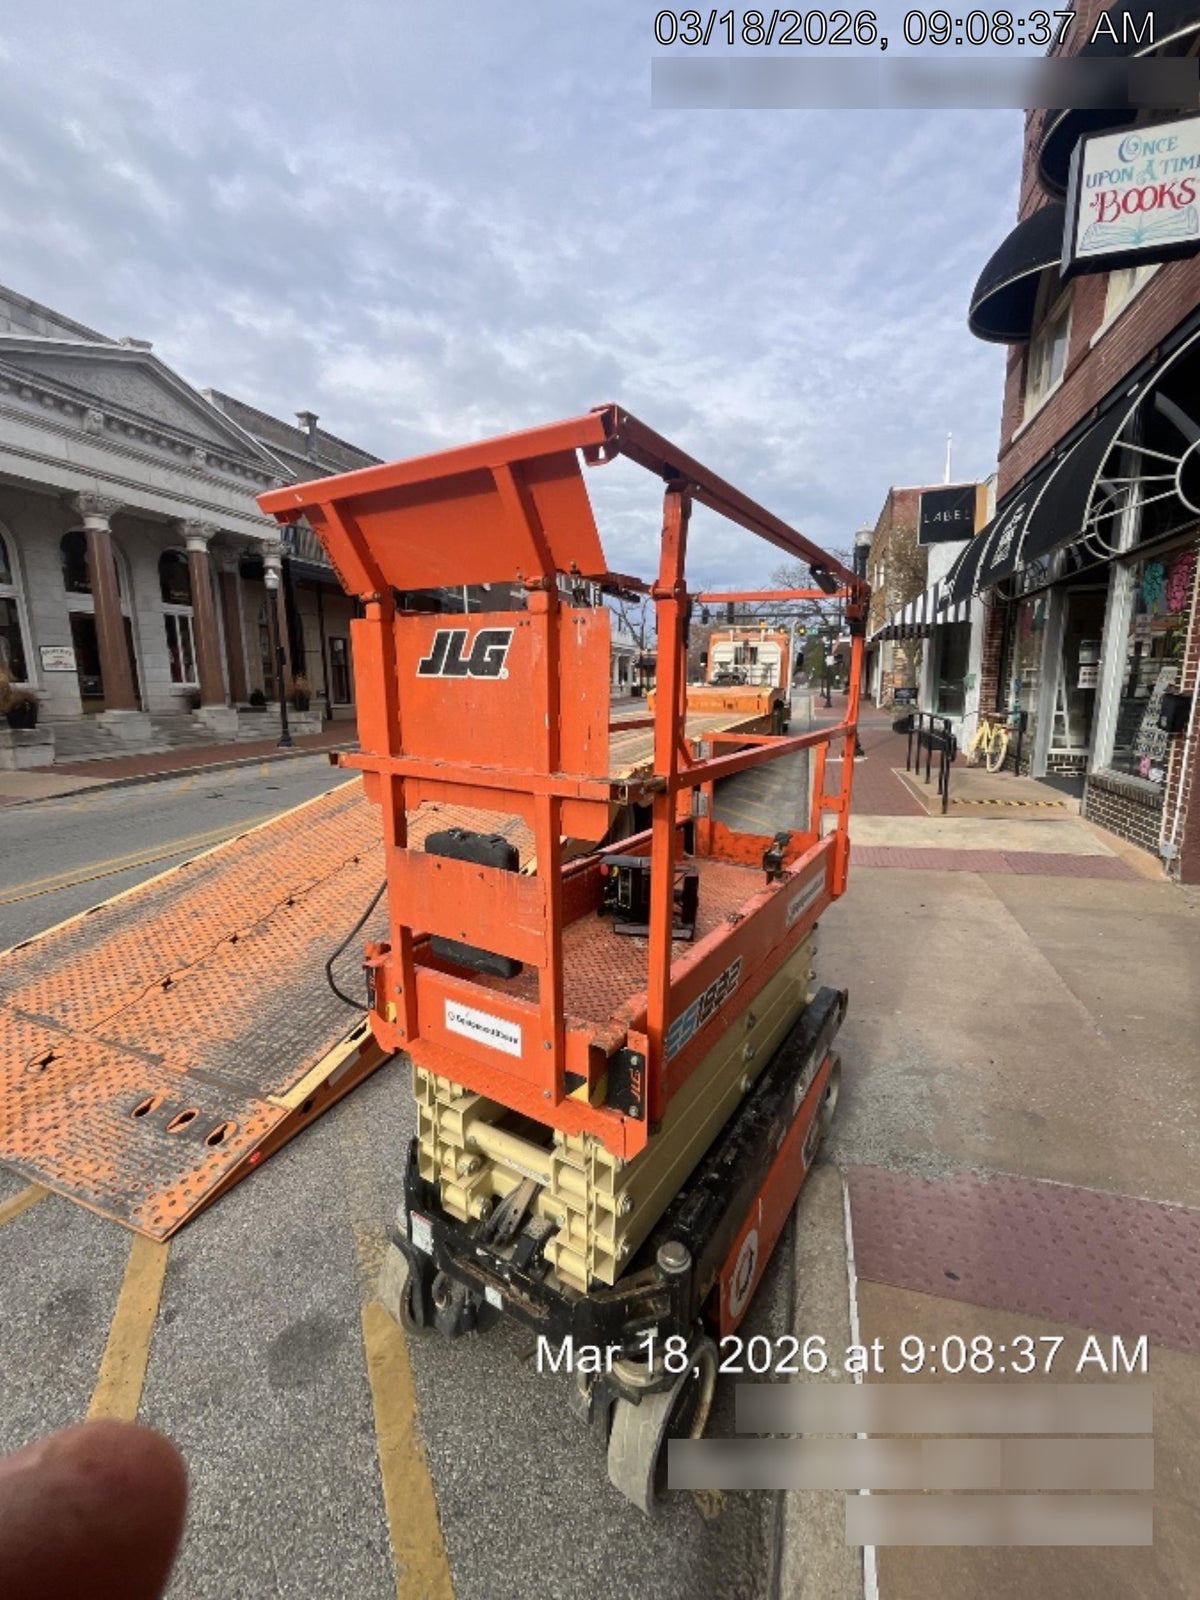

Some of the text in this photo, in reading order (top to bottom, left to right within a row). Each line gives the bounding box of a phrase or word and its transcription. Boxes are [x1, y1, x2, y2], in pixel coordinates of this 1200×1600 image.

[1086, 167, 1135, 188] UPON
[1138, 159, 1157, 184] A
[1089, 177, 1196, 223] BOOKS
[924, 509, 970, 523] LABEL
[416, 627, 515, 680] JLG
